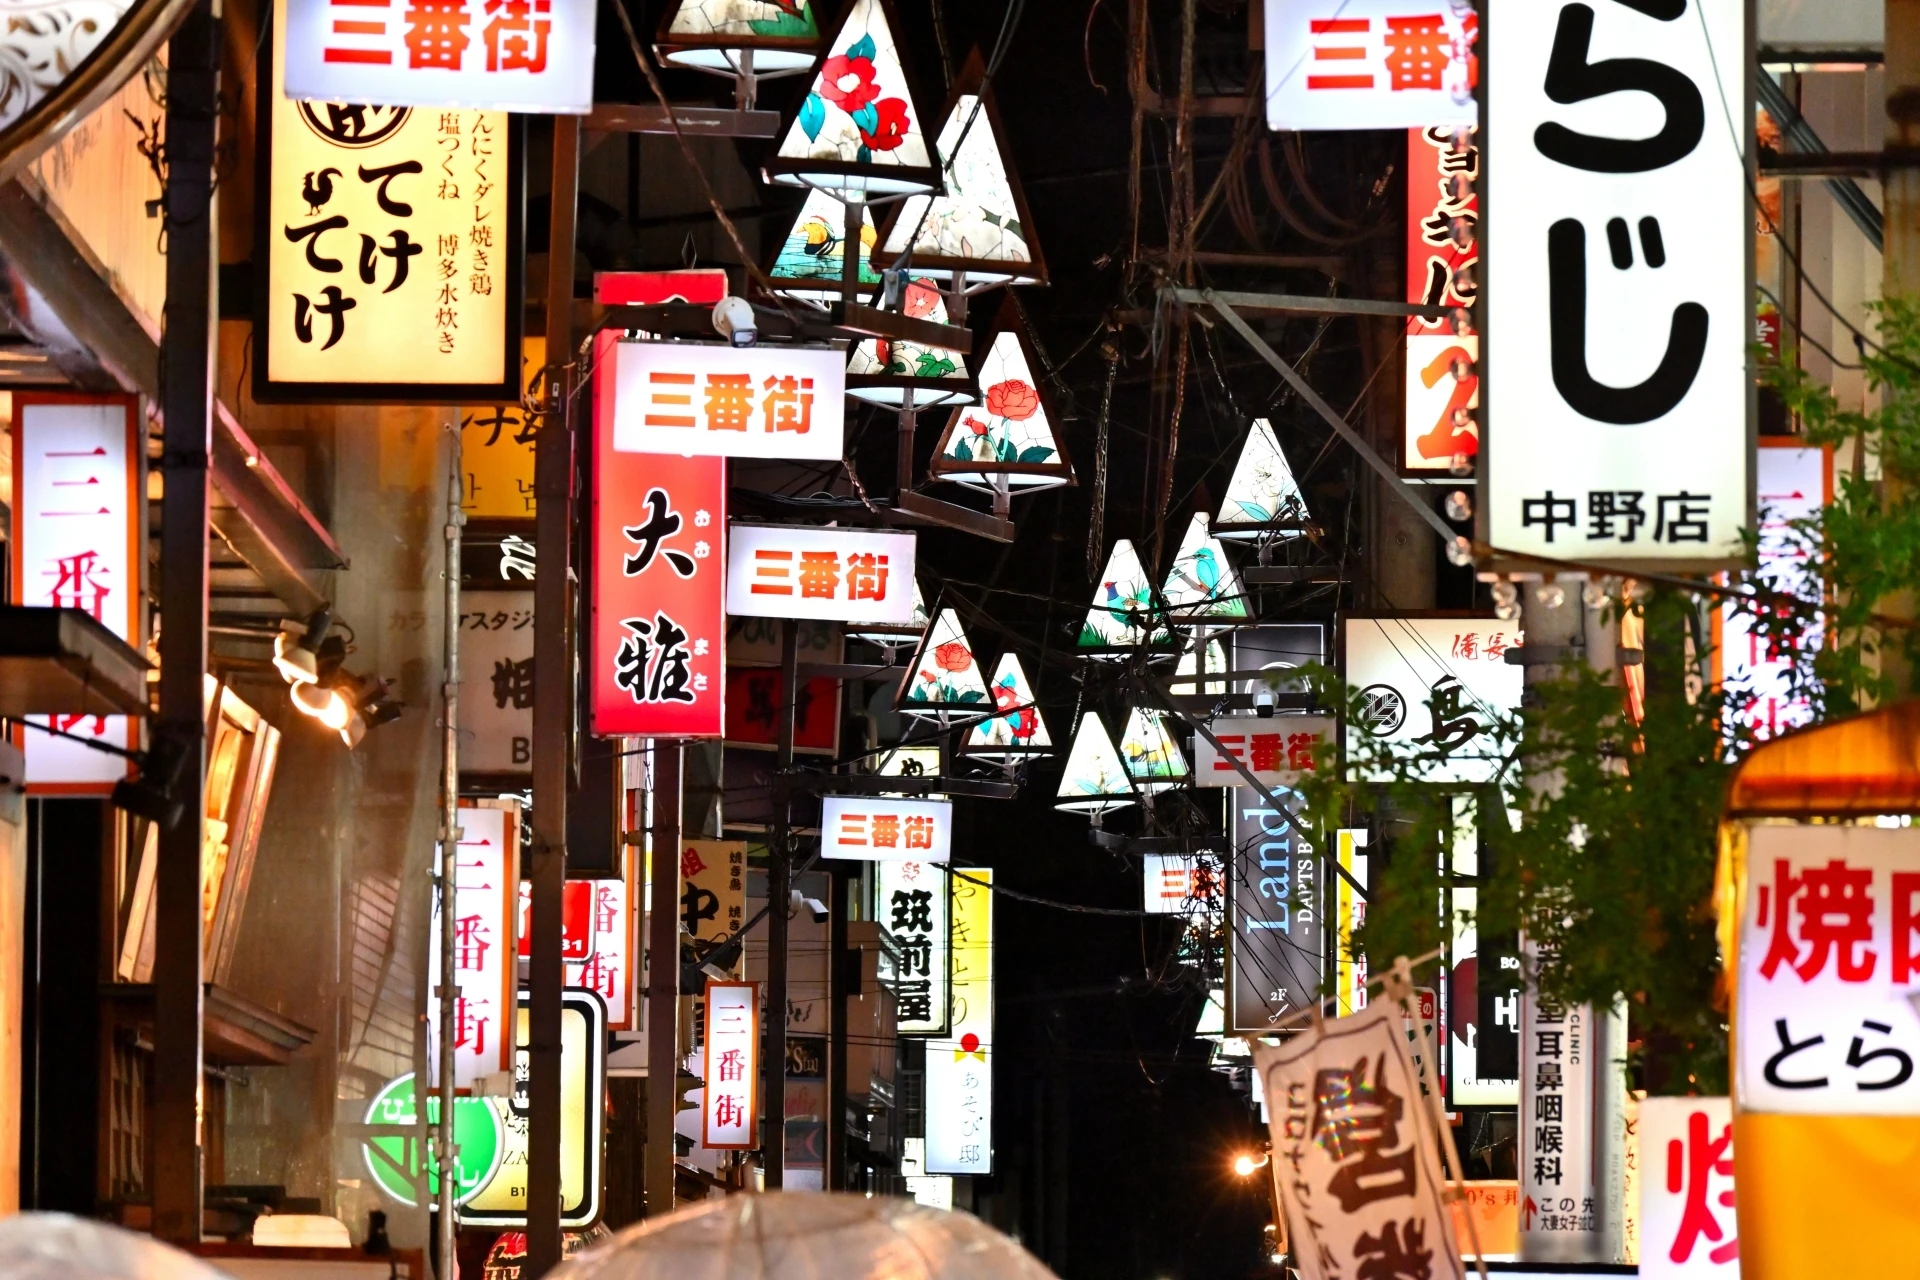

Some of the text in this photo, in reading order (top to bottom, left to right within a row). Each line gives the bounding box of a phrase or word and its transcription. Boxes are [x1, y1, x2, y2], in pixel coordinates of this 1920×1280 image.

[1307, 13, 1478, 91] 三番
[469, 107, 494, 296] んにくダレ焼き鶏
[435, 234, 459, 354] 博多水炊き
[645, 371, 814, 434] 三番街
[1521, 490, 1712, 544] 中野店
[750, 549, 889, 602] 三番街
[838, 814, 934, 850] 三番街
[890, 888, 934, 1023] 筑前屋
[1756, 858, 1920, 985] 焼
[1270, 988, 1288, 1001] 2F
[714, 1004, 747, 1128] 三番街
[1569, 1014, 1581, 1065] CLINIC
[958, 1071, 984, 1164] あそび邸
